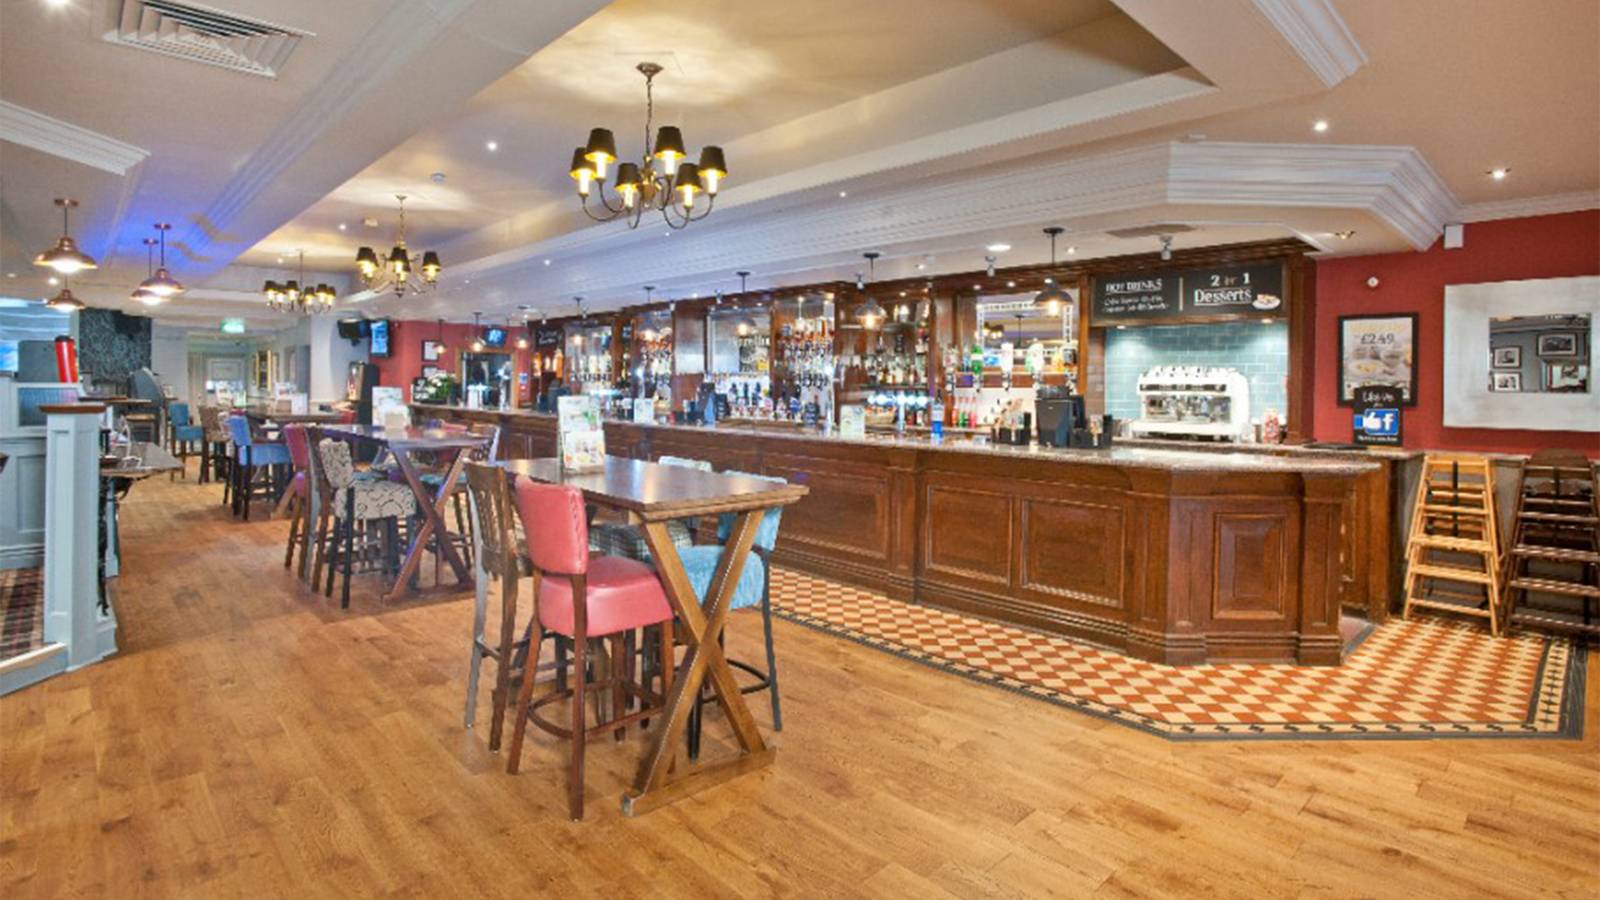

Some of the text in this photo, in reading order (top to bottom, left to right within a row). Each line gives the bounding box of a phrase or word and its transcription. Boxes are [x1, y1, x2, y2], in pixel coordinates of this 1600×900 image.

[1126, 278, 1163, 291] DRINKS
[1210, 275, 1221, 287] 2
[1242, 272, 1251, 285] 1
[1194, 288, 1252, 304] Desserts
